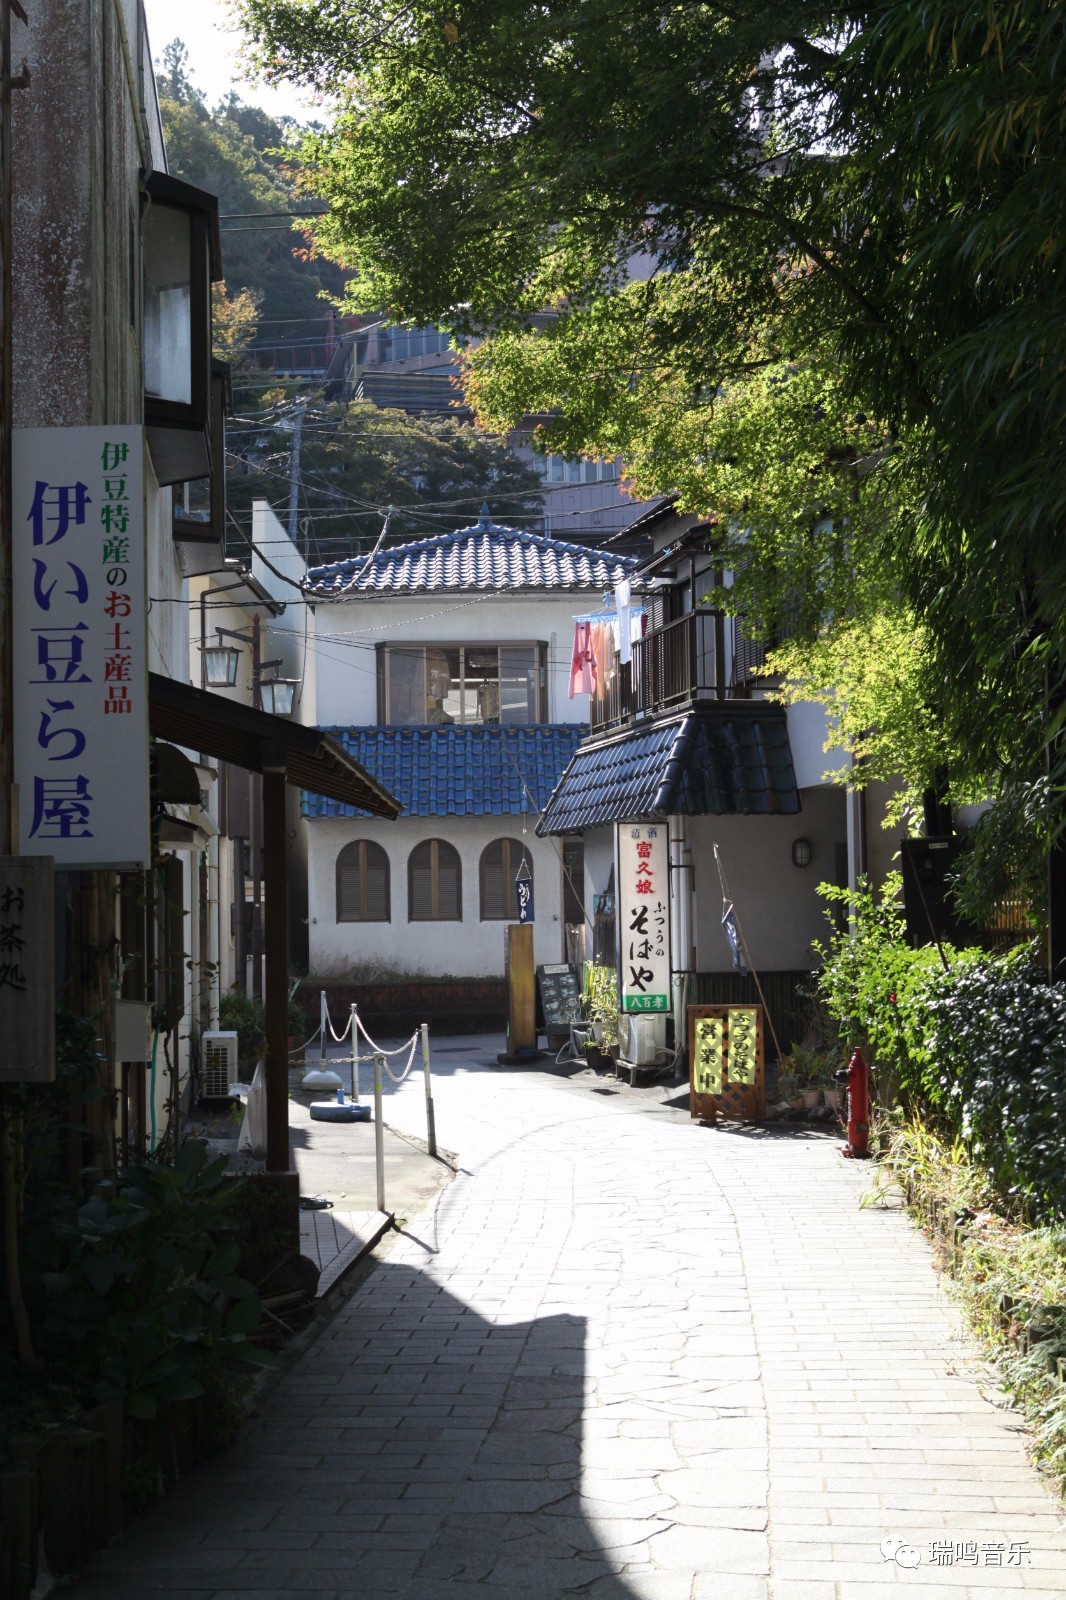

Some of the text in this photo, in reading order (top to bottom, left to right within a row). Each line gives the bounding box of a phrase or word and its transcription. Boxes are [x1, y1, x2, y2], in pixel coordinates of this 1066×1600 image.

[99, 440, 132, 715] 伊豆特産のお土産品
[27, 480, 94, 840] 伊い豆ら屋
[635, 841, 655, 894] 富久娘
[0, 886, 27, 993] お茶処
[629, 905, 654, 992] そばや
[653, 902, 666, 957] ふつうの
[699, 1023, 718, 1089] 営業中
[733, 1012, 751, 1079] ふつうのそばや
